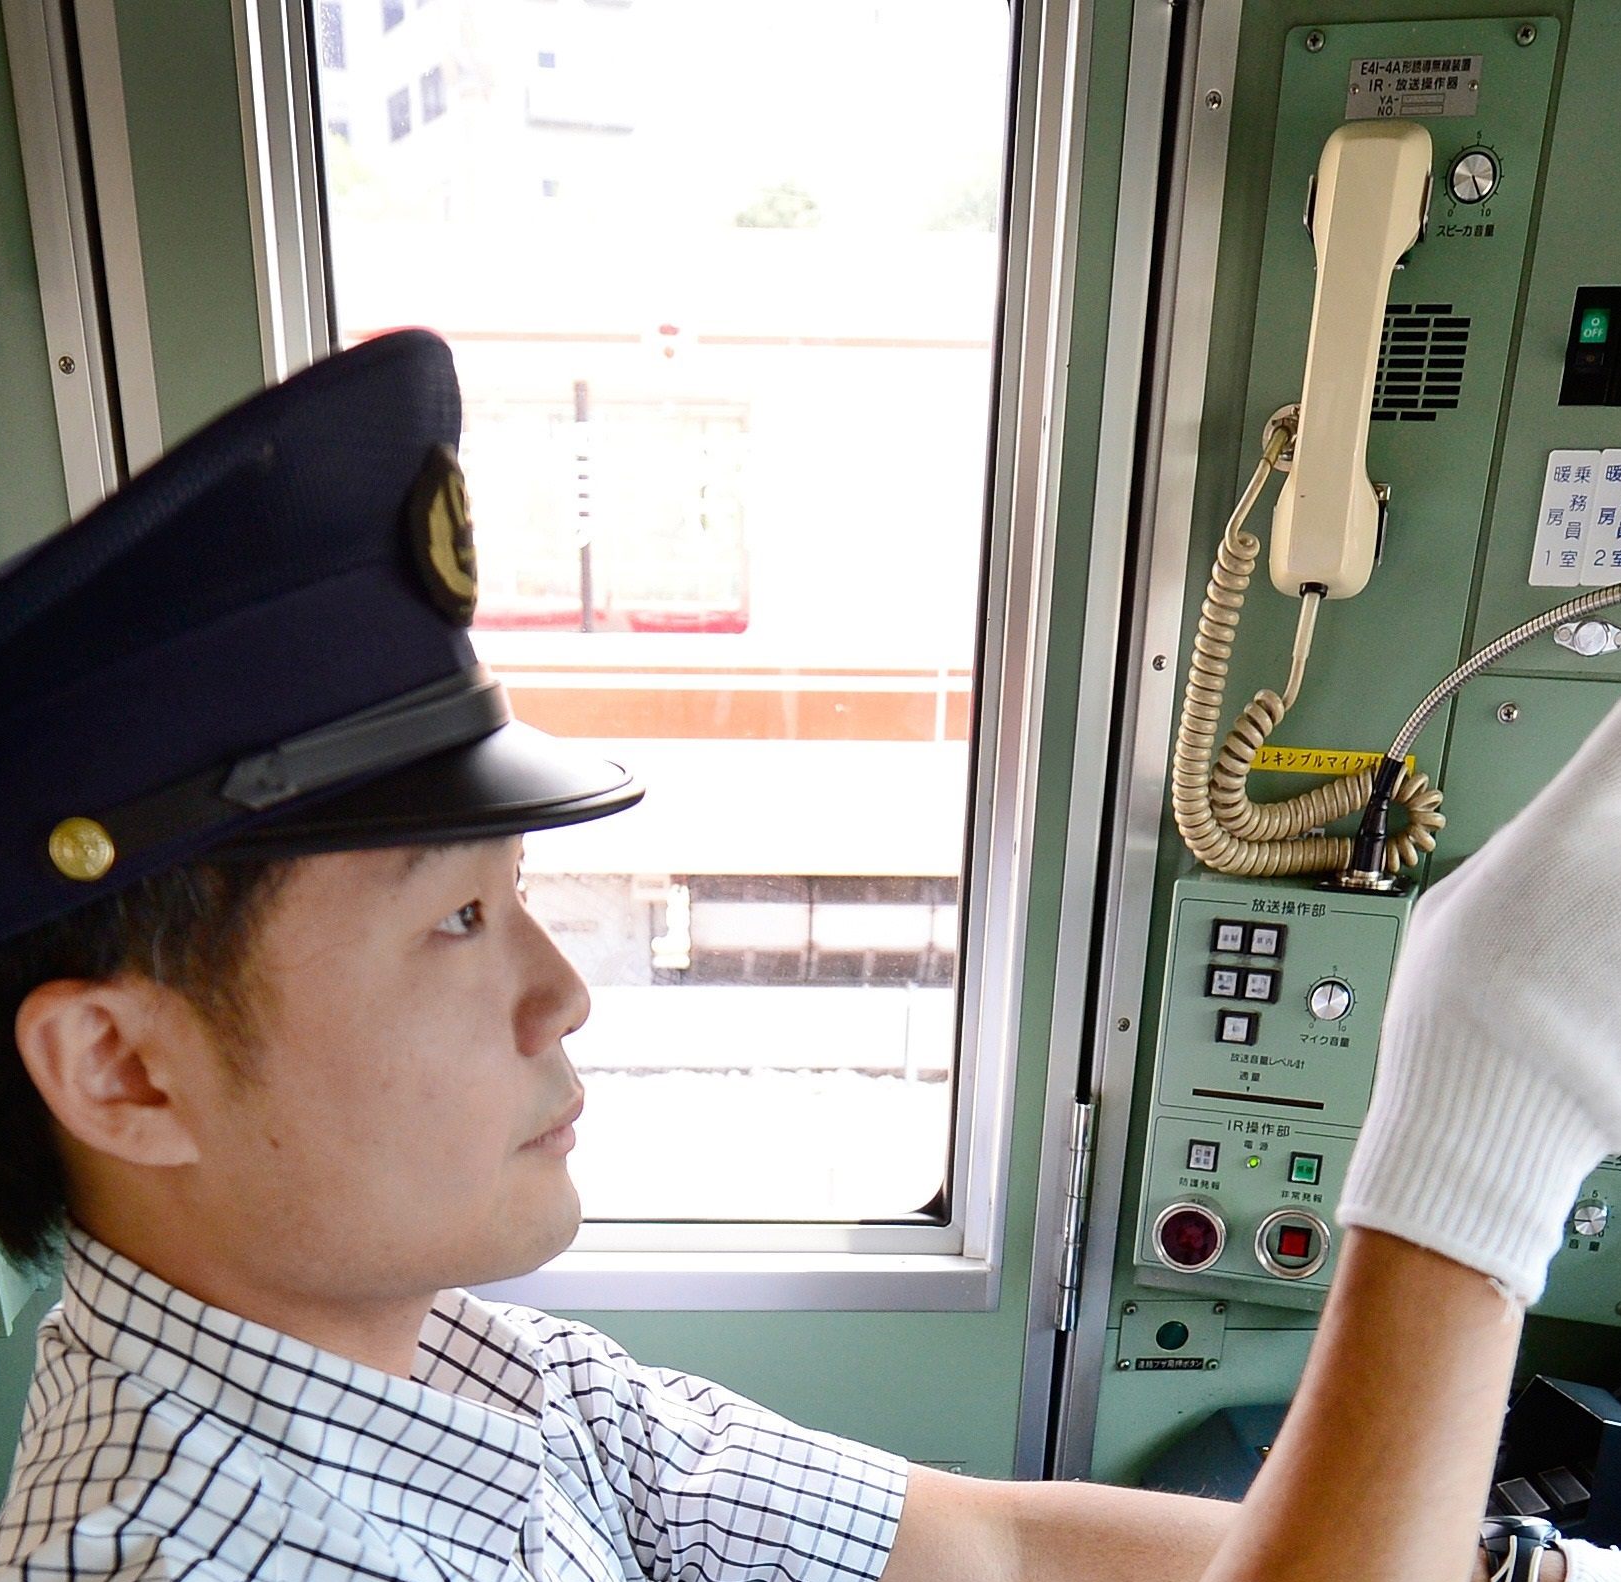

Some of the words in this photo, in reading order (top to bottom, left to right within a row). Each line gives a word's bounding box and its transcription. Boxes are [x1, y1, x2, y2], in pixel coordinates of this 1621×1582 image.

[1480, 208, 1491, 217] 10
[1436, 224, 1495, 237] スピーカ音量
[1584, 329, 1604, 339] OFF
[1559, 464, 1592, 568] 乗務員室
[1251, 898, 1326, 918] 放送操作部
[1299, 1033, 1350, 1048] マイク音量
[1227, 1120, 1290, 1137] IR操作部
